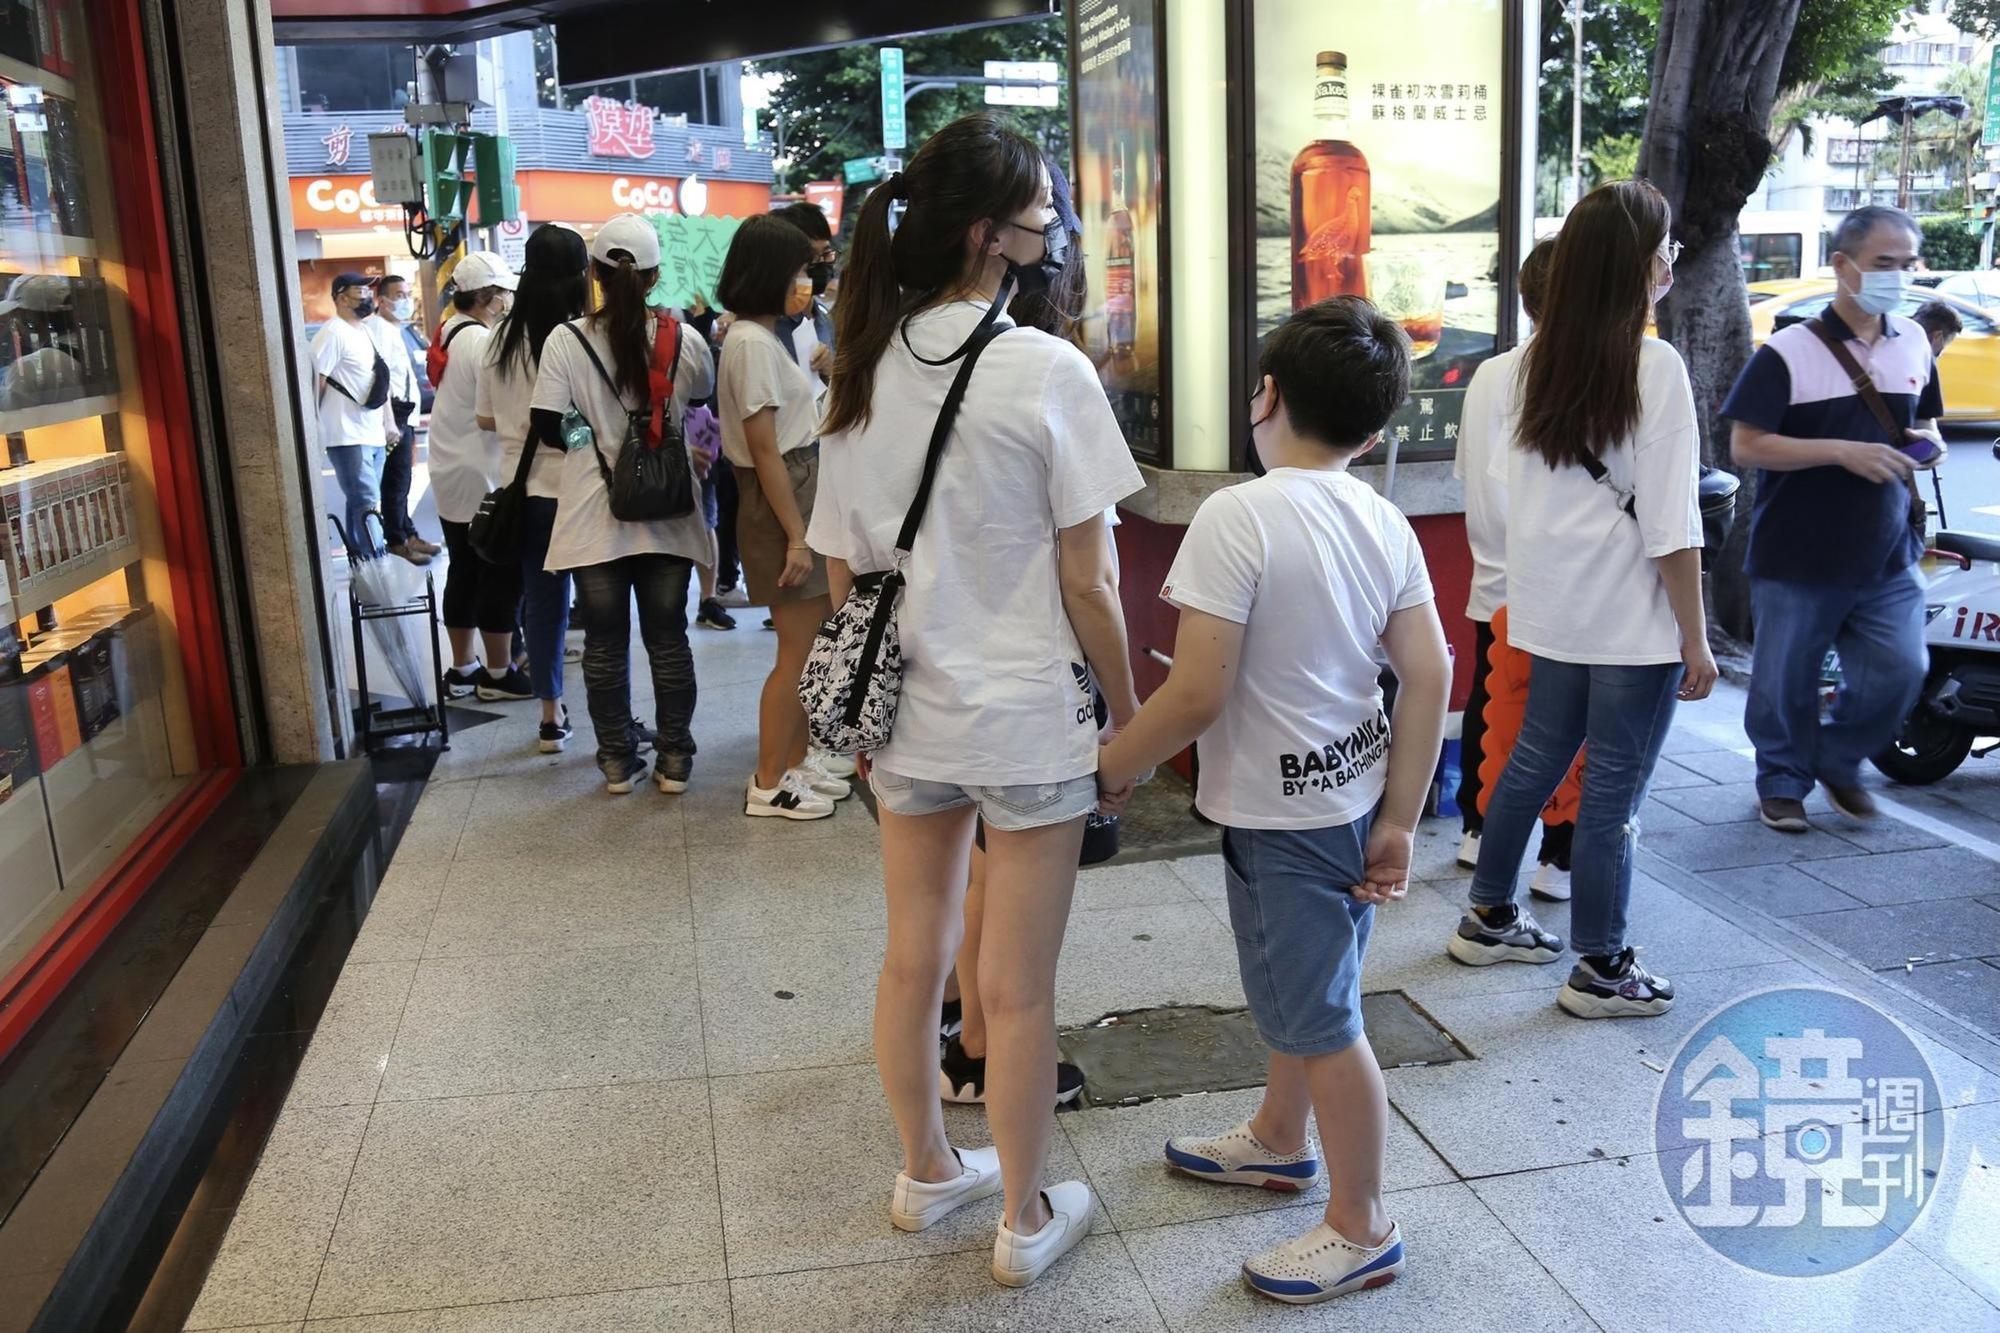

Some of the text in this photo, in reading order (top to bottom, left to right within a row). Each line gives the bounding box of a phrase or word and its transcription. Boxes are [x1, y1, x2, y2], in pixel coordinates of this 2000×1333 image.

[1371, 83, 1488, 100] 裸雀初次雪莉桶
[1371, 104, 1488, 121] 蘇格蘭威士忌
[321, 123, 355, 166] 剪
[612, 177, 675, 210] CoCo
[1283, 780, 1307, 796] BY
